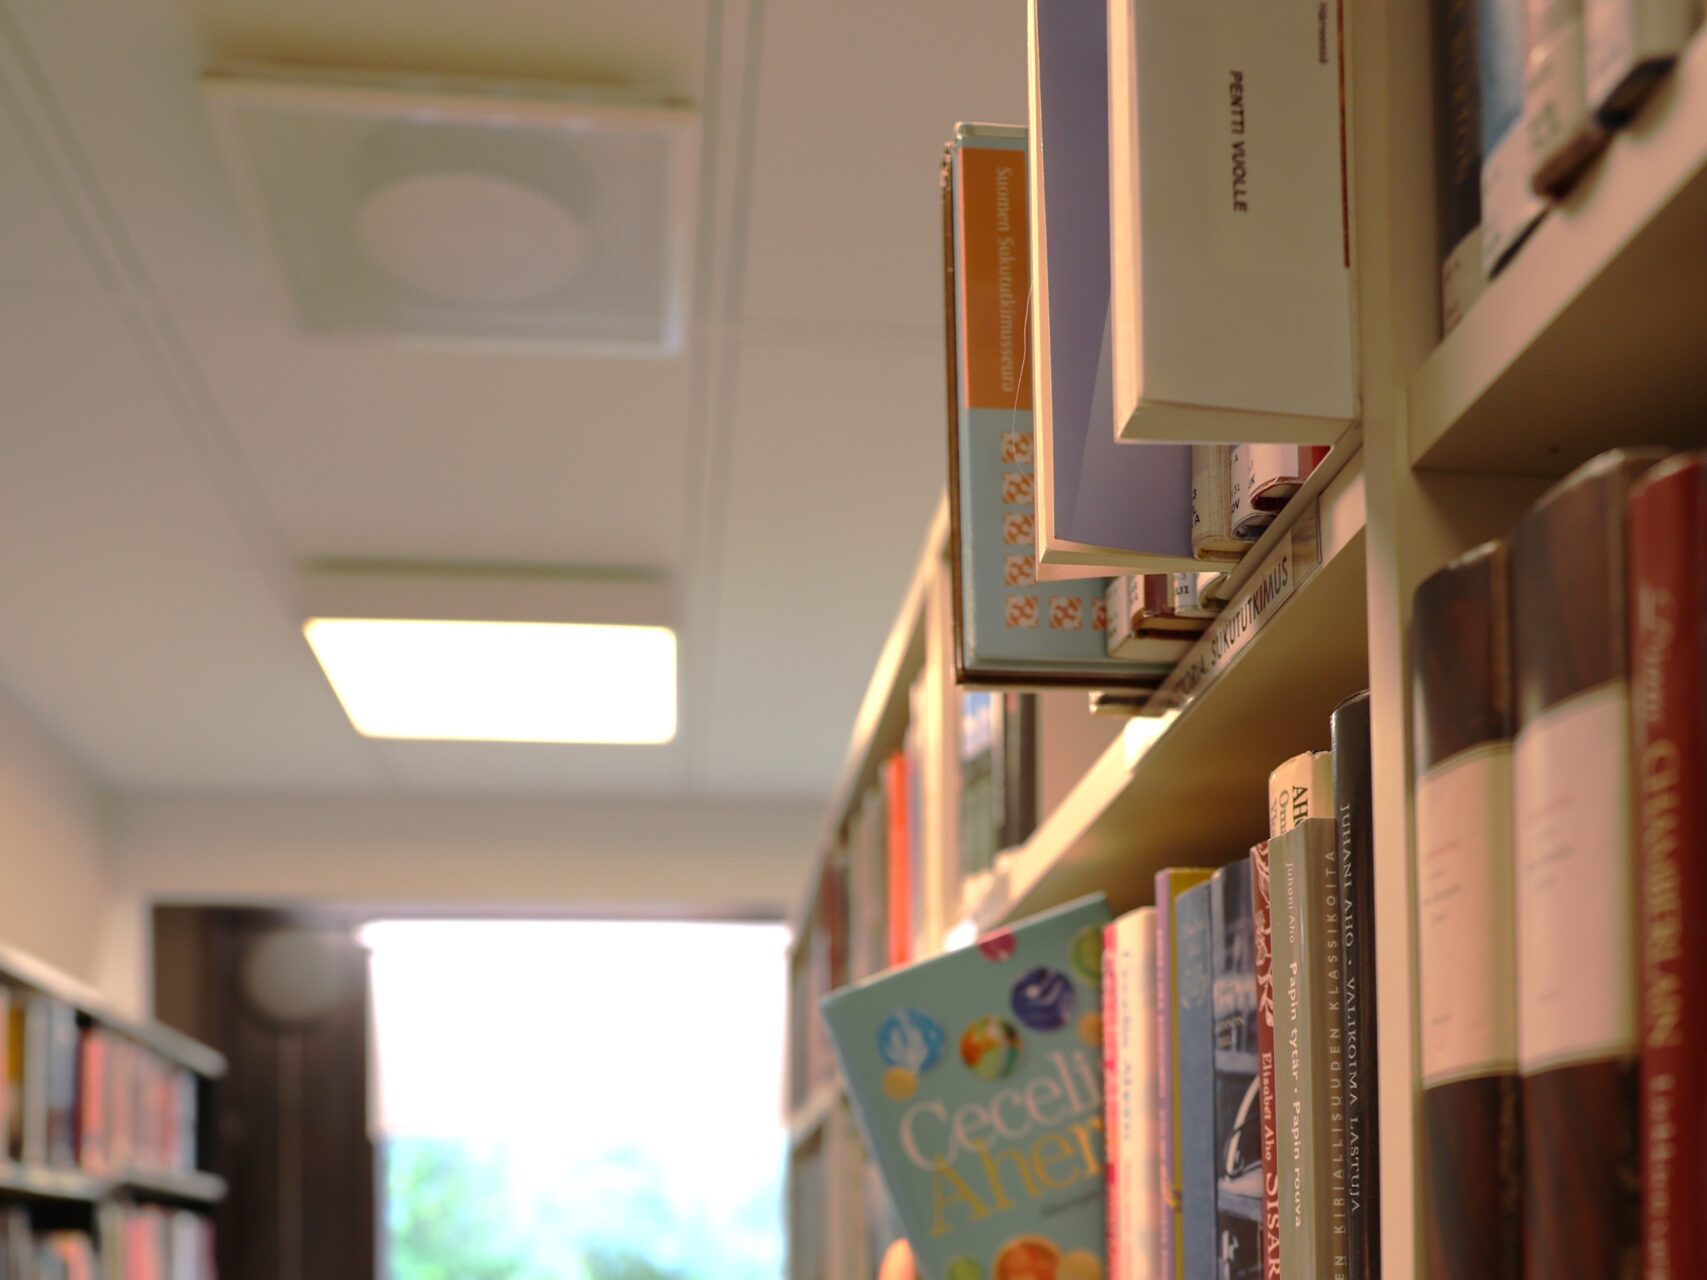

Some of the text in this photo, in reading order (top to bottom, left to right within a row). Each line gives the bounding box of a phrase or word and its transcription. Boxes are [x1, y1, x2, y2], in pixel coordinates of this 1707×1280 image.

[1229, 69, 1248, 213] PENTTI VUOLLE
[995, 166, 1017, 392] Suomen Sukututkimusseura
[1210, 555, 1289, 666] SUKUTUTKIMUS
[1292, 785, 1309, 828] AH
[1285, 862, 1298, 944] Juhani Aho
[1325, 851, 1340, 1011] KLASSIKOITA
[1339, 804, 1361, 1214] JUHANI AHO VALIKOIMA LASTUJA
[1261, 1051, 1274, 1120] Elisabet
[1265, 1125, 1275, 1161] Aho
[1287, 960, 1304, 1228] Papin tytär Papin rouva
